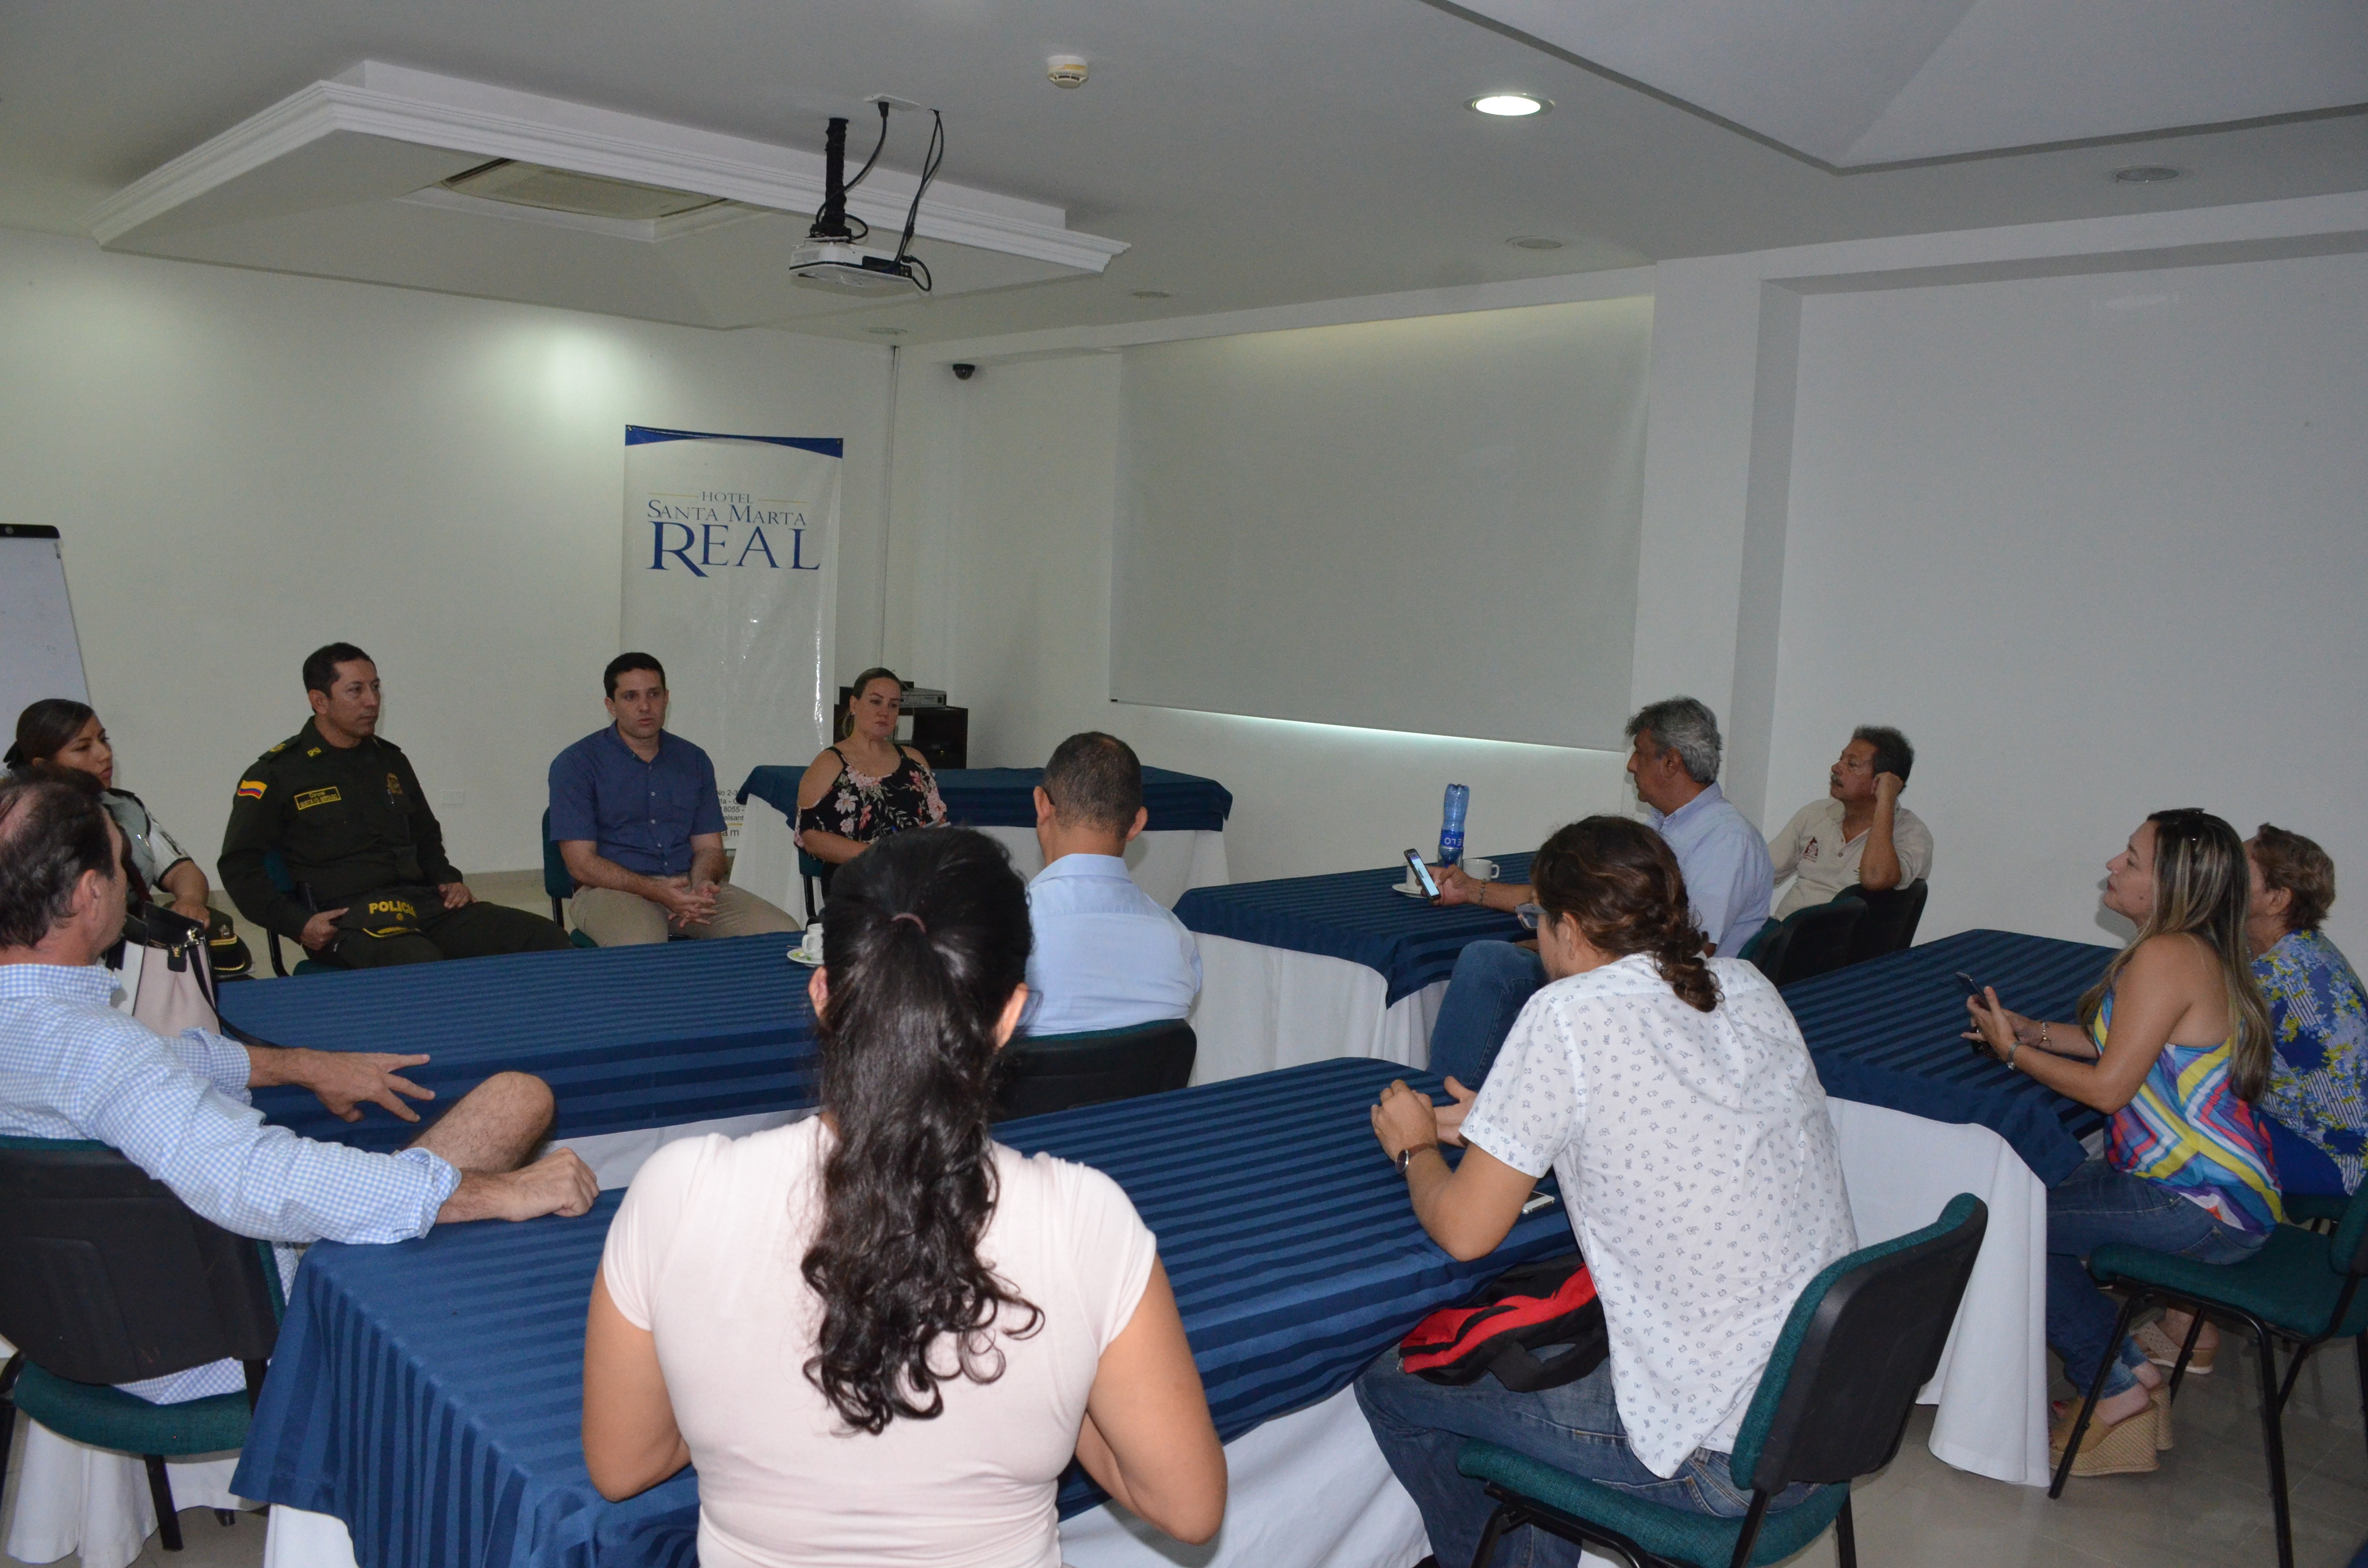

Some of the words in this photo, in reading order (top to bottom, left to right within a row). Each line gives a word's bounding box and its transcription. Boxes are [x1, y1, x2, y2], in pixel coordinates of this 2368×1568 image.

[702, 491, 753, 503] HOTEL
[648, 500, 718, 521] SANTA
[729, 504, 806, 526] MARTA
[646, 521, 821, 577] REAL
[1444, 837, 1463, 846] ELO
